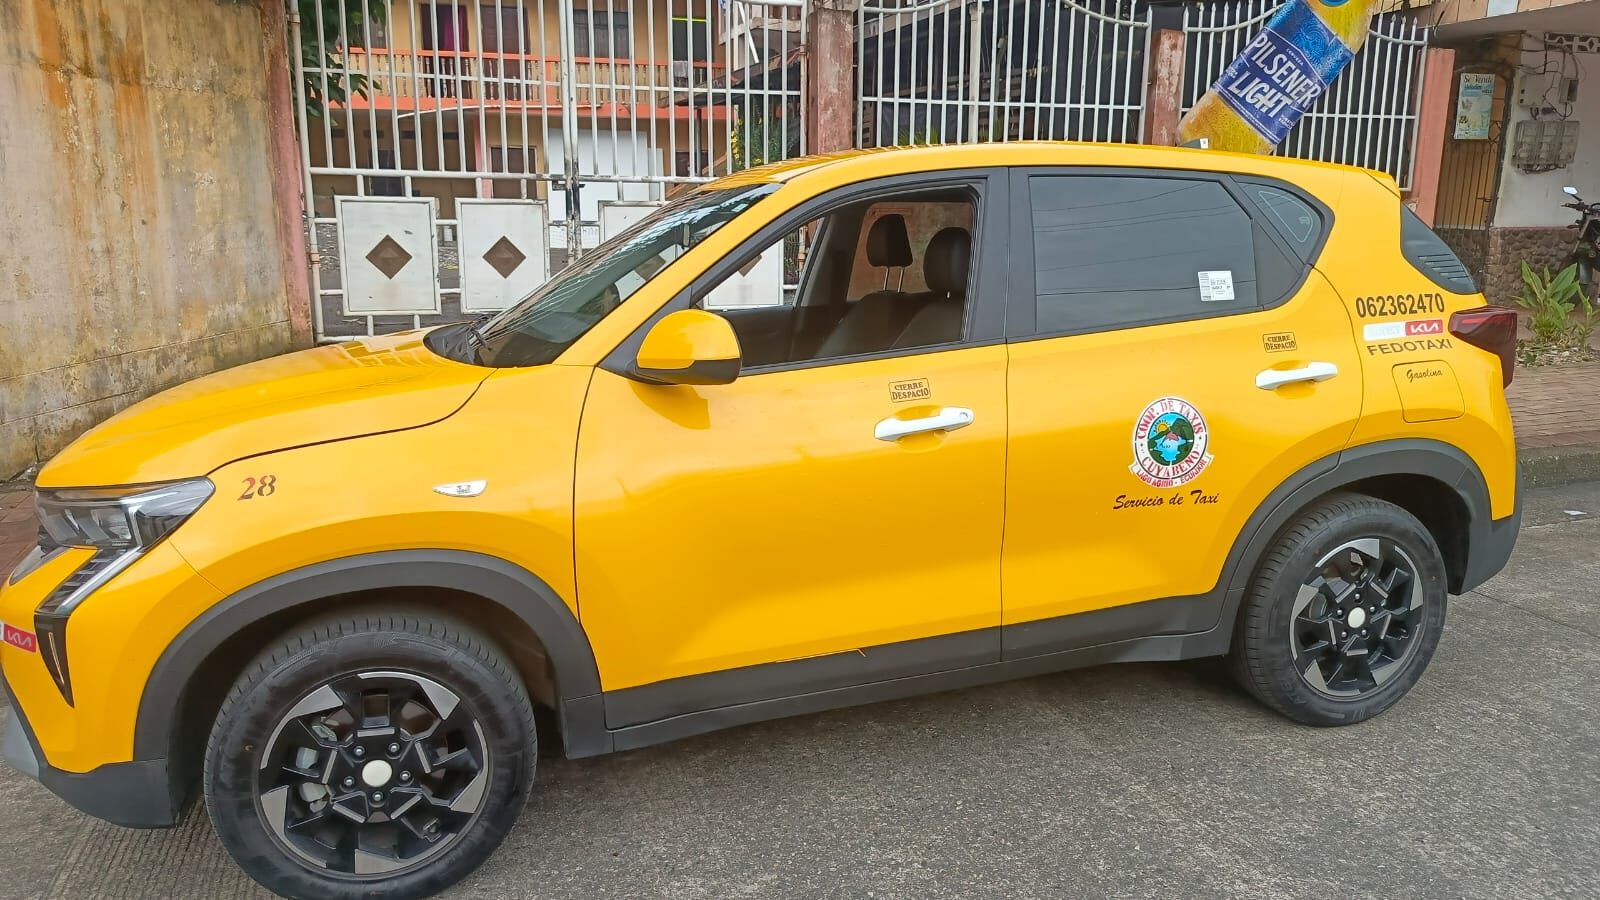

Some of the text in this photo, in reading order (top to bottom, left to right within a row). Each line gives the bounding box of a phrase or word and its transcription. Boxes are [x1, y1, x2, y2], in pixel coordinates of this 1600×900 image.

[1244, 33, 1321, 108] PILSENER
[1463, 74, 1471, 83] Se
[1227, 70, 1294, 118] LIGHT
[1355, 293, 1445, 318] 062362470
[1410, 322, 1440, 334] KIA
[1265, 341, 1296, 350] DESPACIO
[1366, 339, 1453, 356] FEDOTAXI
[1406, 368, 1443, 383] Gasolina
[892, 387, 929, 400] DESPACIO
[894, 382, 923, 390] CIERRE
[1160, 400, 1175, 413] DE
[1178, 402, 1204, 435] TAXIS
[1136, 469, 1152, 484] LAGO
[1180, 459, 1207, 484] ECUADOR
[1141, 450, 1200, 477] CUYABENO
[237, 474, 276, 501] 28
[1113, 489, 1220, 510] Servicio de Taxi
[7, 629, 32, 648] KIA
